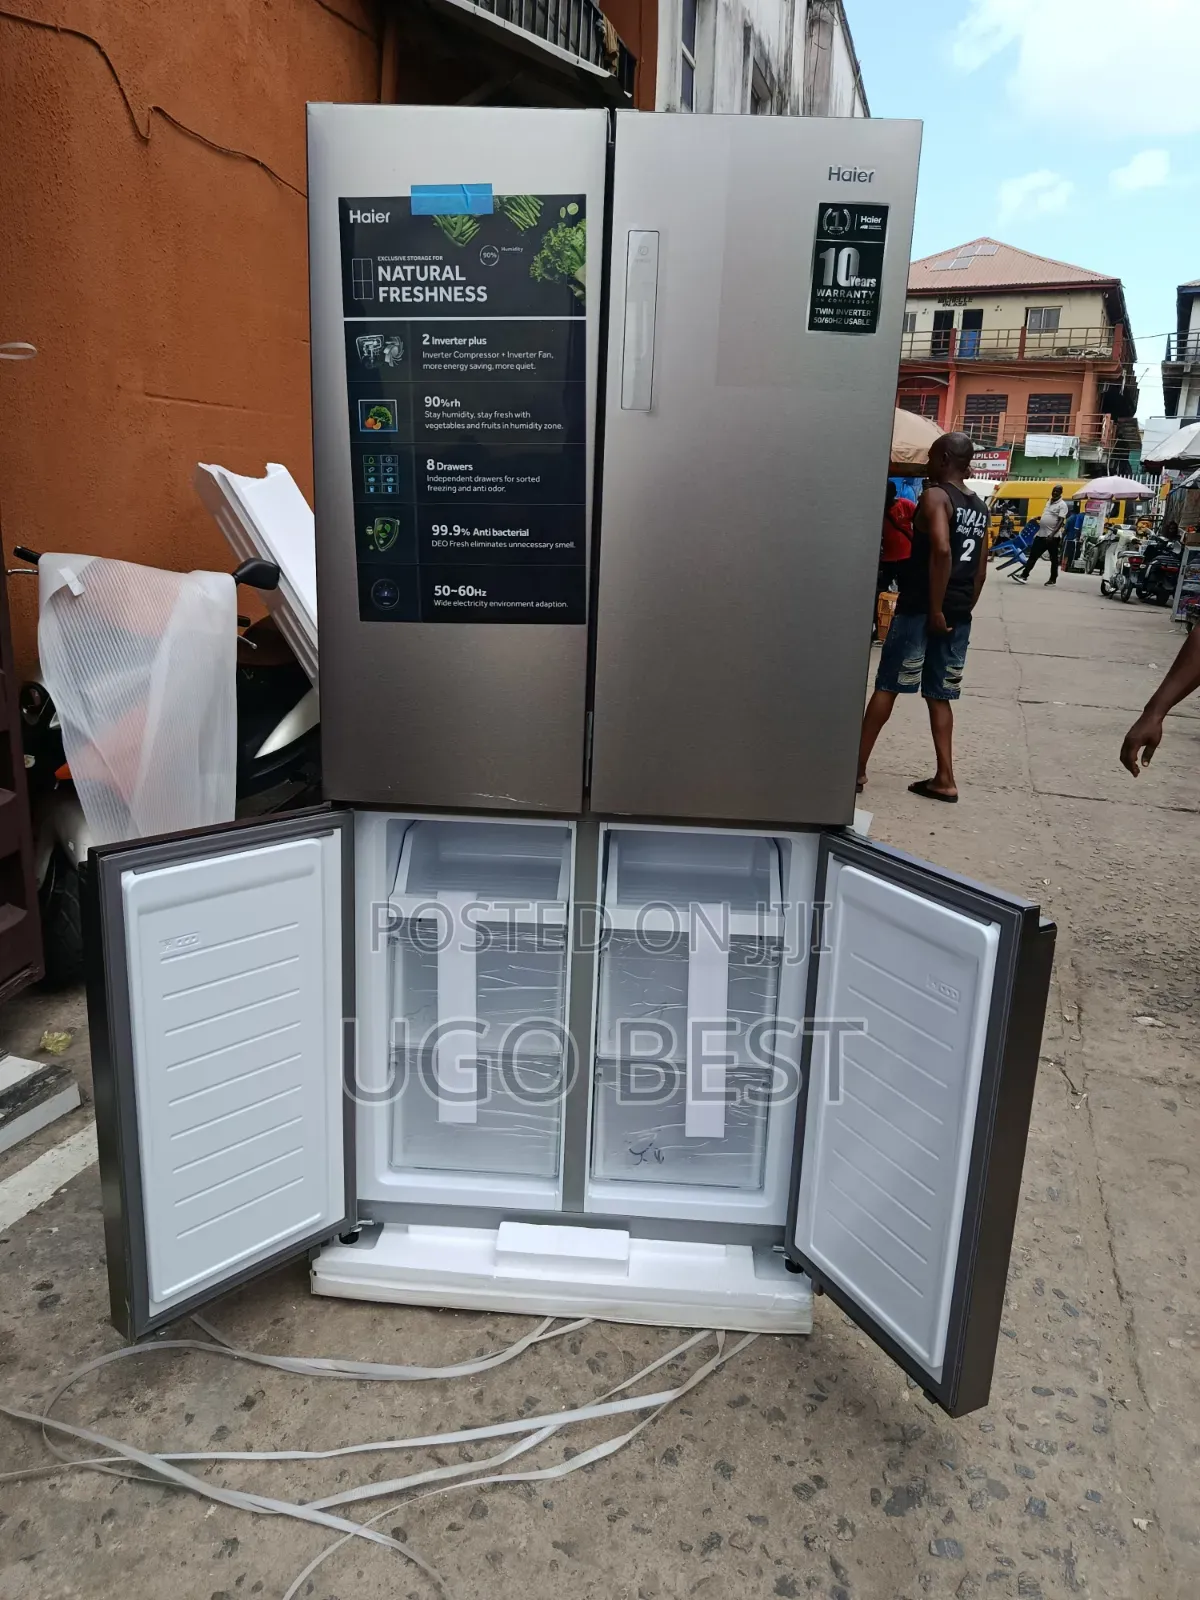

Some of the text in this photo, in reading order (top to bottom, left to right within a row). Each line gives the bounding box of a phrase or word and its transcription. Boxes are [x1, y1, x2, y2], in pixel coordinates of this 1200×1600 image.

[828, 167, 875, 183] Haier
[349, 209, 390, 223] Haier
[860, 216, 882, 224] Haier
[378, 265, 466, 281] NATURAL
[819, 247, 877, 288] 10 Years
[379, 286, 487, 302] FRESHNESS
[816, 288, 875, 299] WARRANTY
[815, 307, 871, 316] TWIN INVERTER
[844, 318, 871, 326] USABLE
[422, 334, 487, 347] 2 Inverter plus
[453, 351, 499, 360] Compressor
[538, 351, 554, 359] Fan,
[469, 363, 494, 371] saving,
[424, 396, 460, 407] 90%rh
[424, 411, 441, 419] Stay
[442, 411, 475, 419] humidity,
[477, 411, 492, 419] stay
[425, 422, 465, 430] vegetables
[510, 422, 542, 431] humidity
[426, 459, 473, 470] 8 Drawers
[427, 475, 473, 483] Independent
[428, 484, 457, 493] freezing
[432, 525, 530, 536] 99.9% Anti bacterial
[470, 540, 507, 548] eliminates
[960, 538, 976, 561] 2
[434, 585, 487, 596] 50~60Hz
[453, 600, 488, 608] electricity
